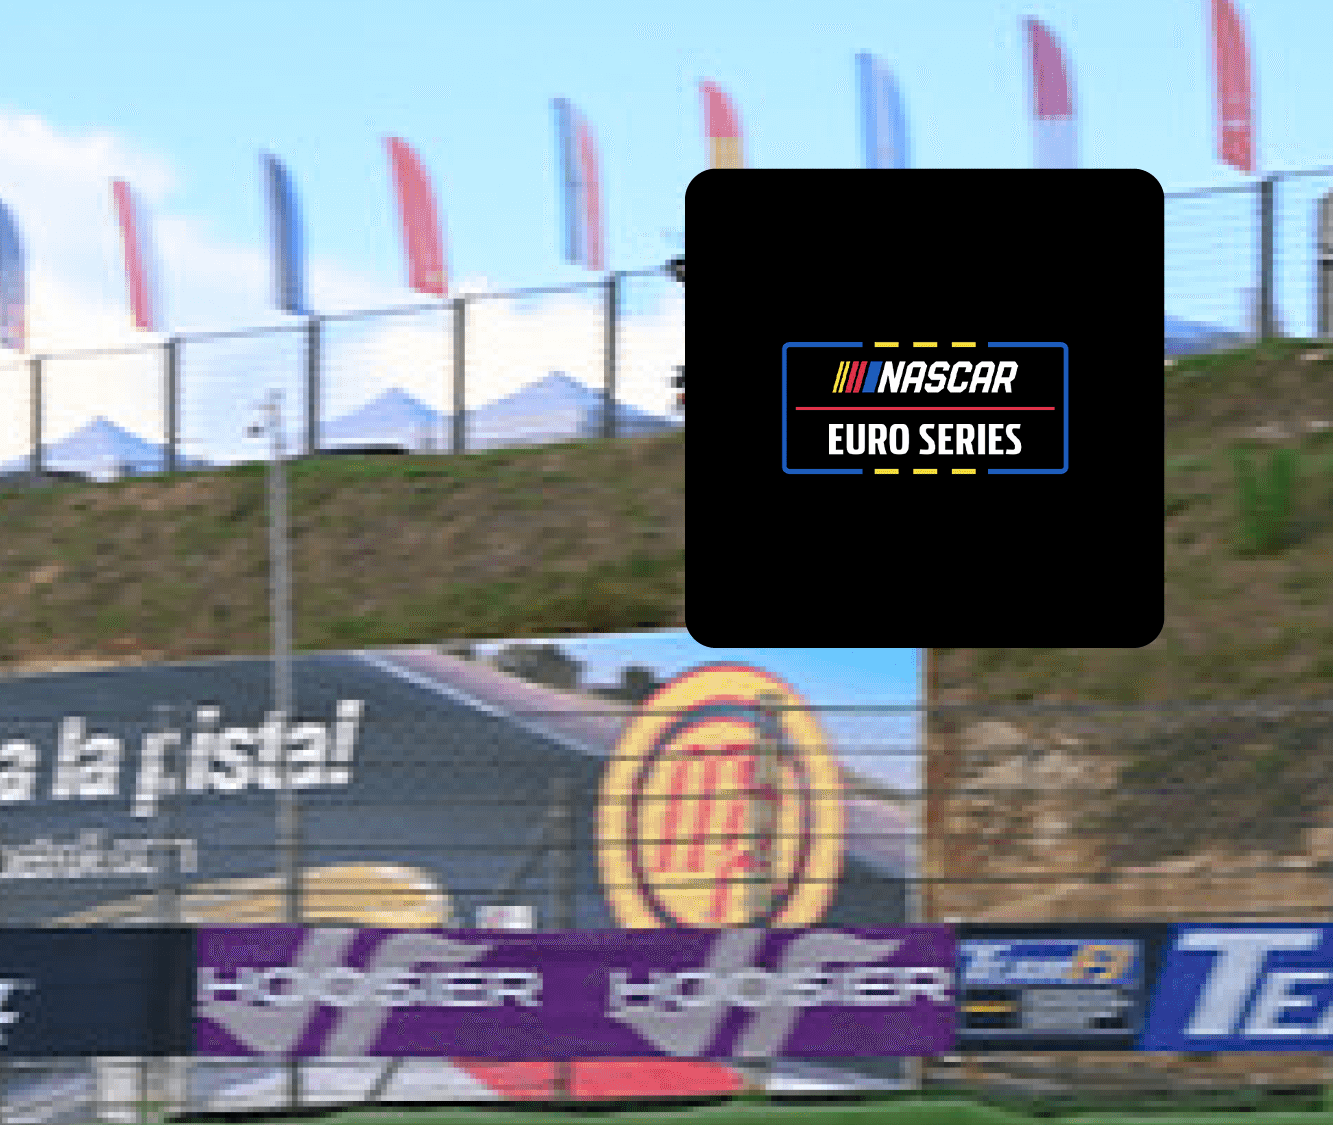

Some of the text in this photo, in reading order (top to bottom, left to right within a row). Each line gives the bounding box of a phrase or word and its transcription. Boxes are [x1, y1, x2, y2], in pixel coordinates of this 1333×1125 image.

[52, 716, 124, 798] la
[197, 966, 544, 1008] HOOSIER
[605, 964, 952, 1011] HOOSIER
[1177, 928, 1333, 1037] TE
